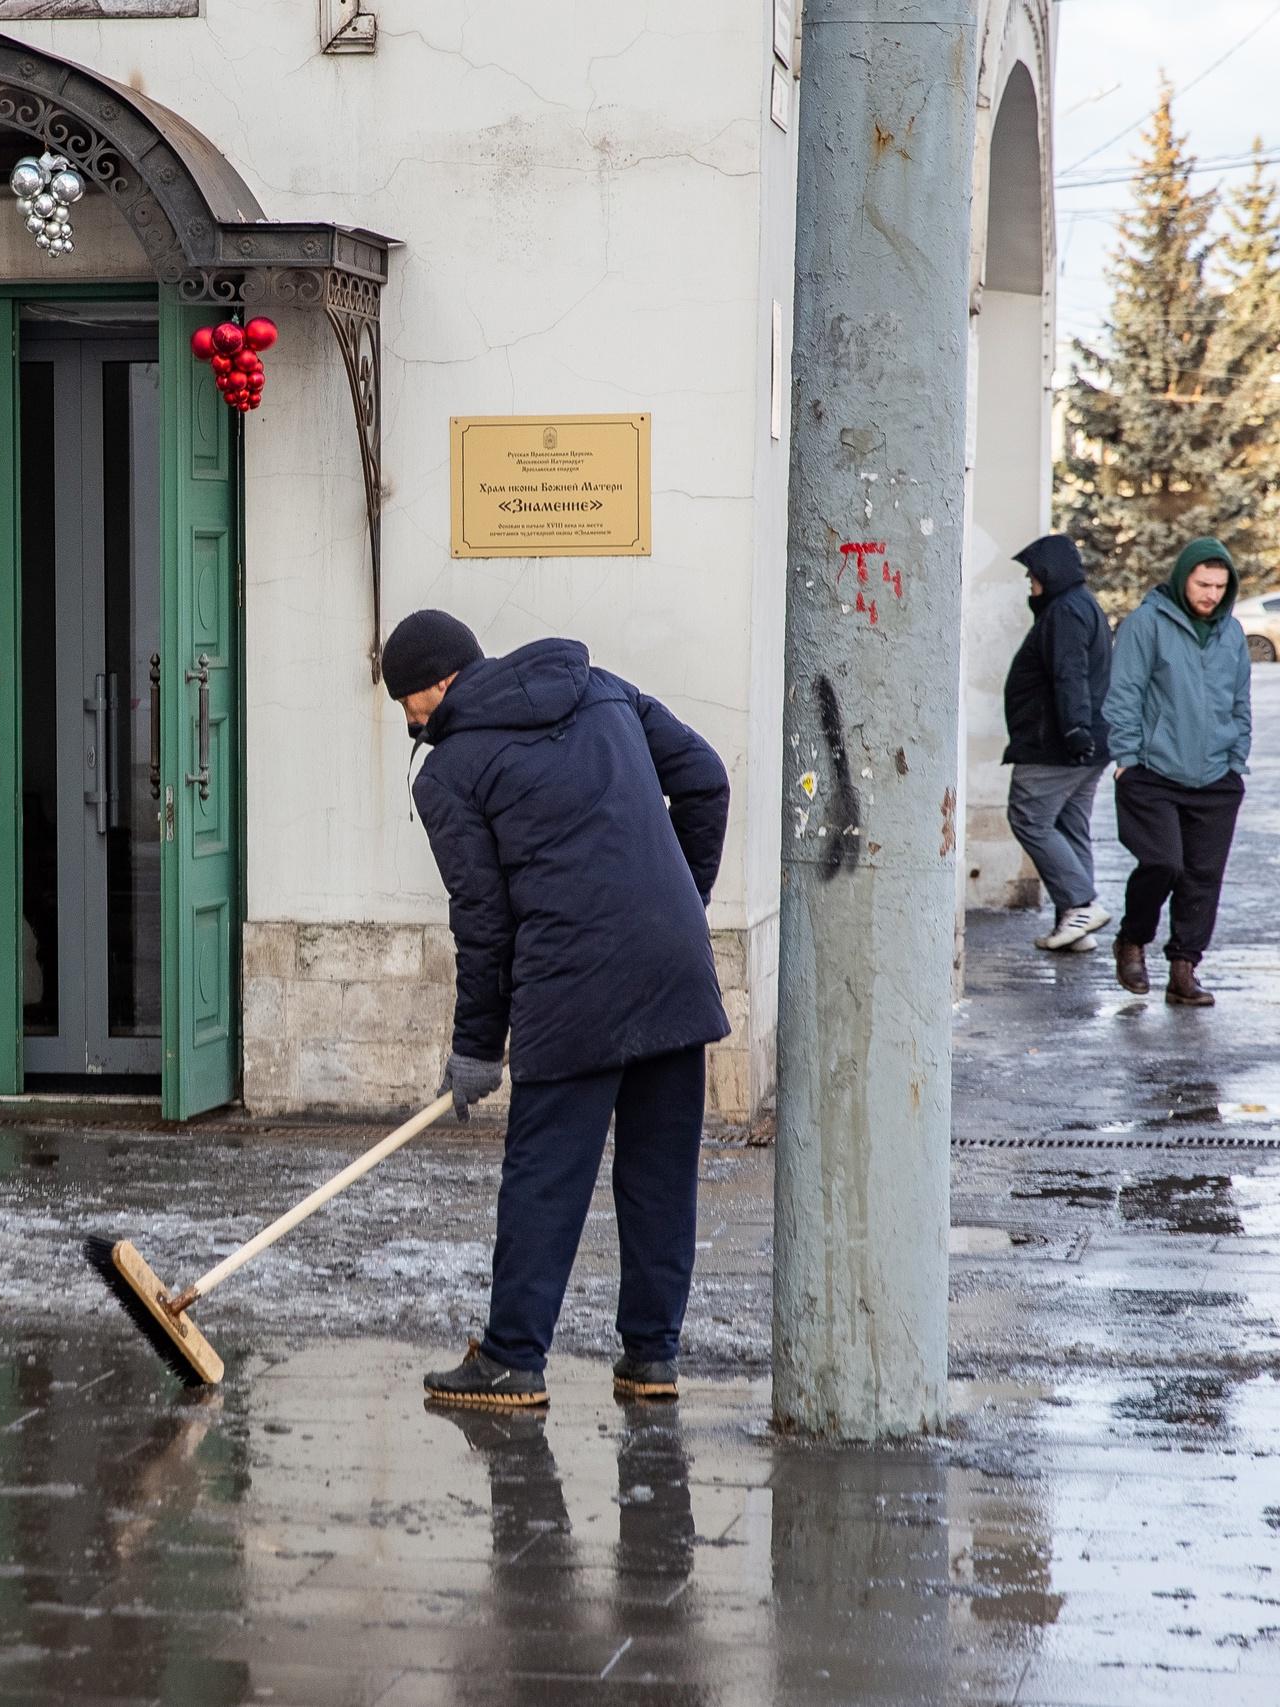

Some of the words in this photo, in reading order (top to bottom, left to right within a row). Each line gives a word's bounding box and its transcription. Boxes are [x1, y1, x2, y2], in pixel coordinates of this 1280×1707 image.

[550, 458, 584, 466] Патриархат
[479, 482, 506, 495] Храм
[508, 484, 538, 493] иконы
[541, 483, 578, 493] Божией
[581, 482, 623, 494] Матери
[498, 498, 603, 514] «Знамение»
